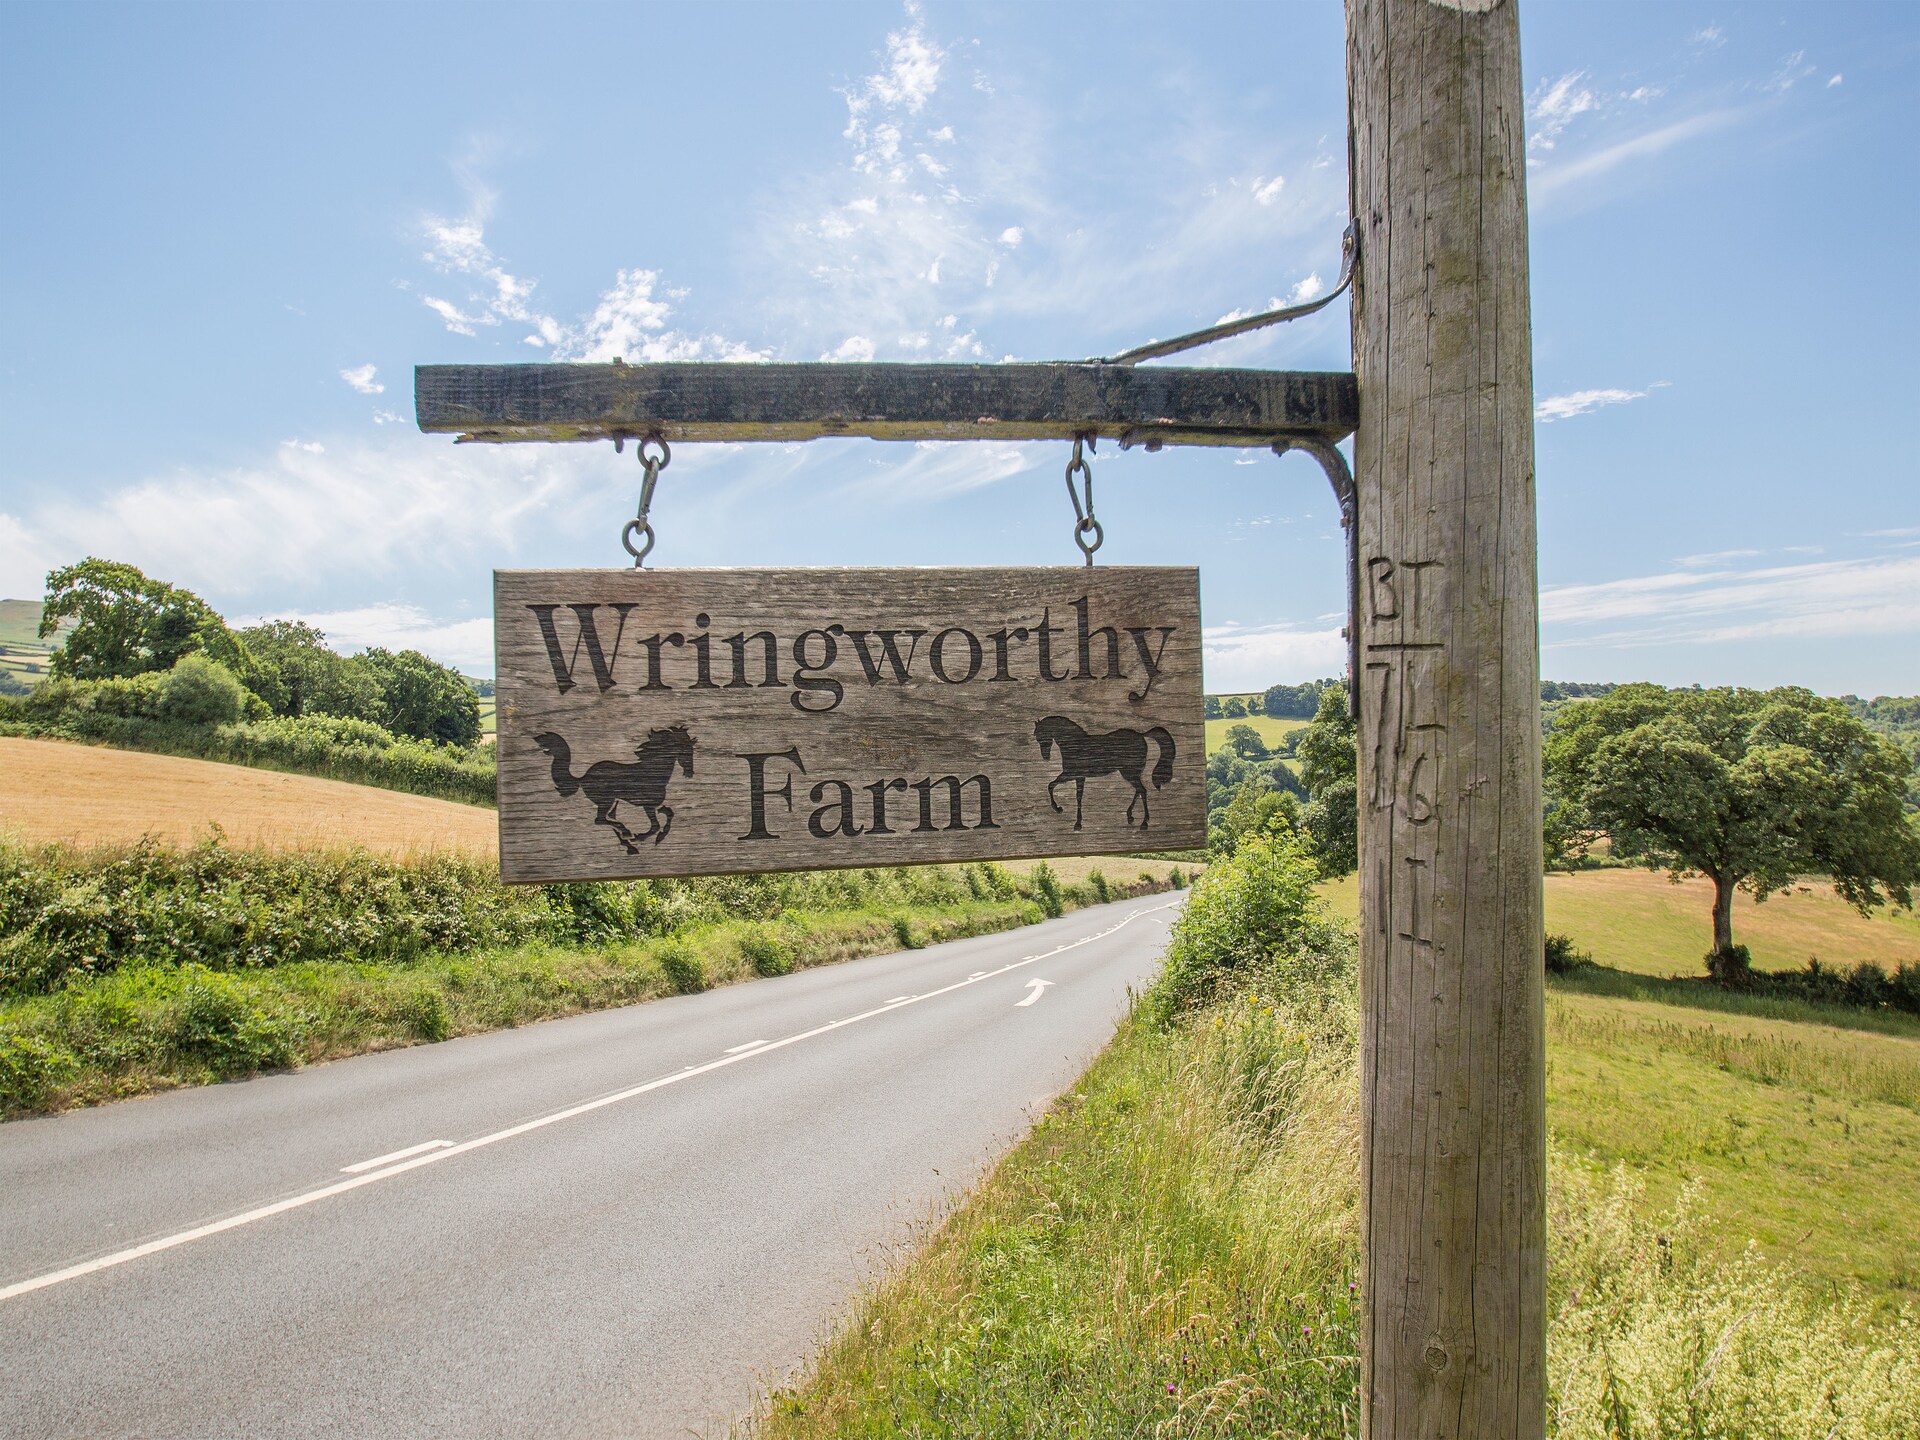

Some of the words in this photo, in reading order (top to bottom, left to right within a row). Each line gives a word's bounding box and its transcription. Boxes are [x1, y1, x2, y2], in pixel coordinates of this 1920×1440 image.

[1368, 557, 1445, 630] BT
[526, 596, 1176, 712] Wringworthy
[736, 746, 1002, 841] Farm
